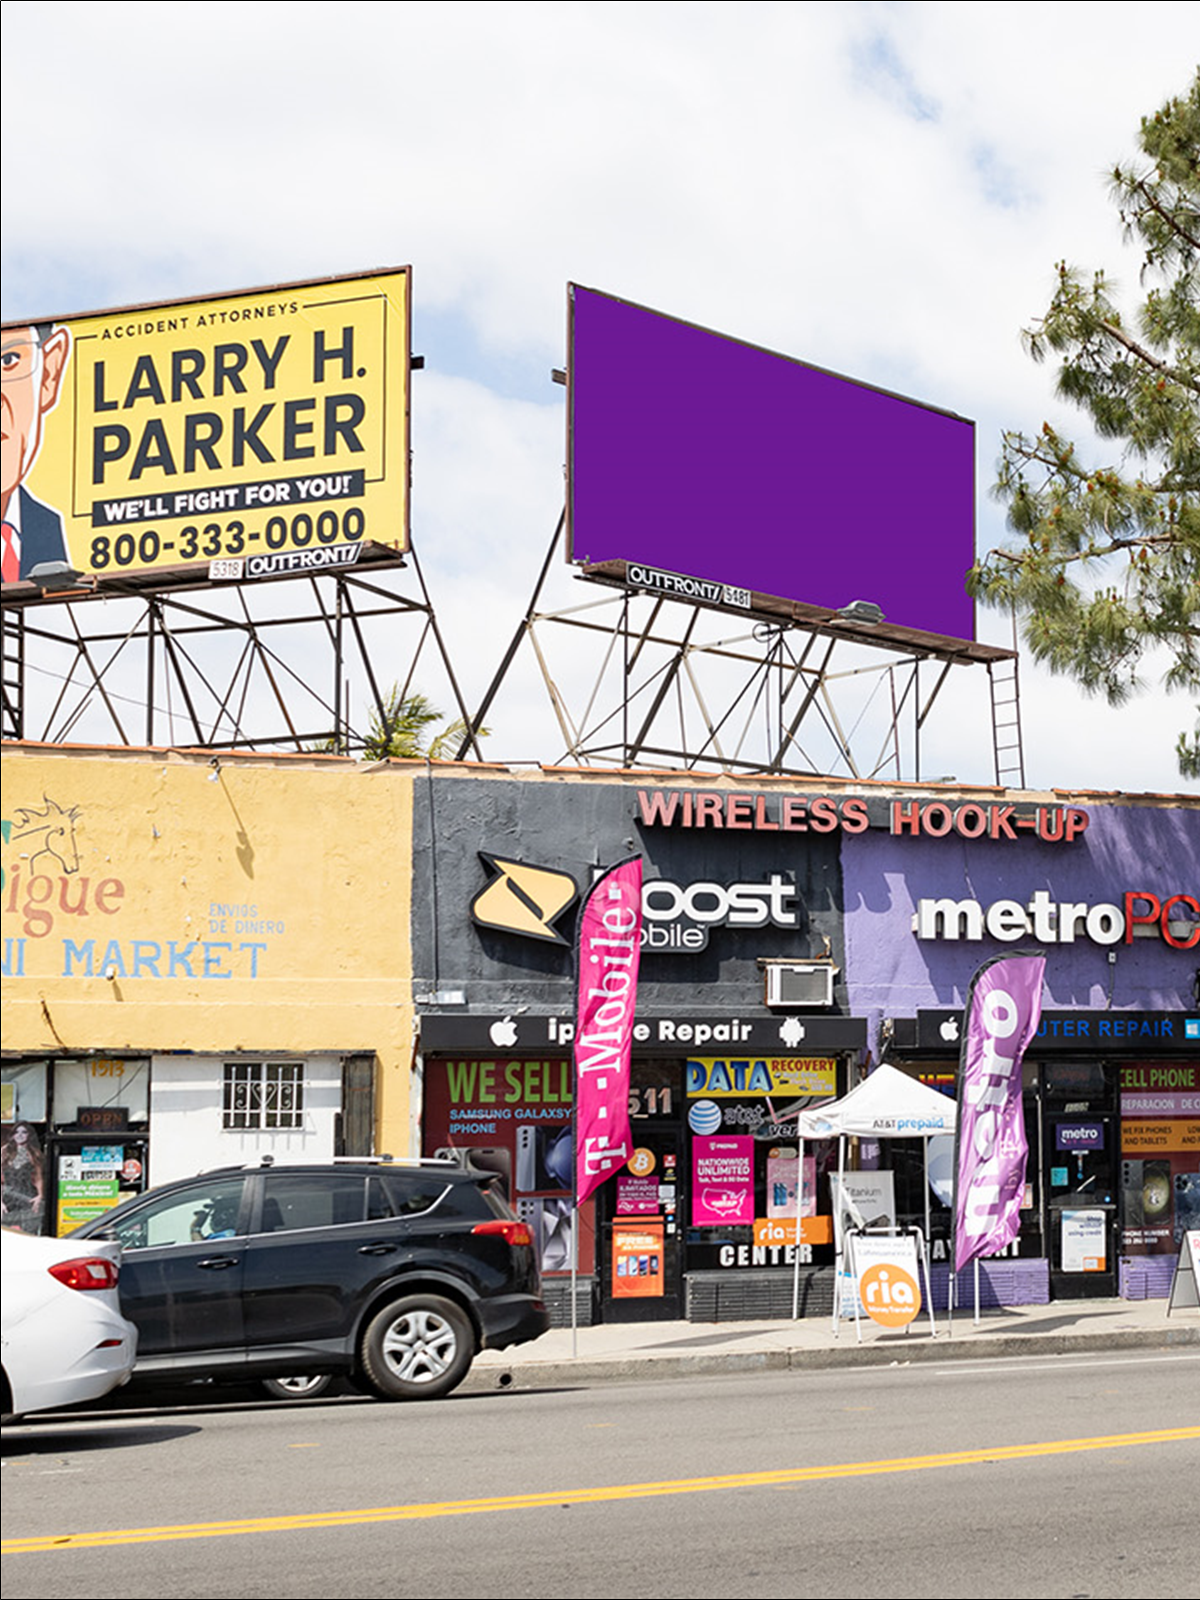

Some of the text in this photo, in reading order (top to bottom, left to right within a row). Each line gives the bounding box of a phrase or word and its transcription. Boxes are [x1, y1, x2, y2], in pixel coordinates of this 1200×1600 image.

[101, 302, 299, 341] ACCIDENT ATTORNEYS
[93, 326, 367, 413] LARRY H.
[92, 392, 365, 485] PARKER
[103, 475, 352, 522] WE'LL FIGHT FOR YOU!
[90, 507, 365, 569] 800-333-0000
[212, 561, 240, 577] 5318
[725, 586, 751, 607] 5481
[637, 789, 1090, 843] WIRELESS HOOK-UP
[1, 863, 126, 938] igue
[593, 868, 796, 925] oost
[209, 903, 259, 918] ENVIOS
[209, 920, 285, 934] DE DINERO
[640, 923, 704, 948] obile
[61, 940, 268, 979] MARKET
[659, 1020, 752, 1042] Repair
[1036, 1020, 1174, 1037] UTER REPAIR
[91, 1060, 125, 1078] 1513
[687, 1059, 835, 1092] DATA RECOVERY
[1150, 1068, 1195, 1087] PHONE
[446, 1061, 573, 1103] WE SELL
[1121, 1099, 1175, 1110] REPARACION
[1181, 1099, 1192, 1109] DE
[81, 1111, 122, 1129] OPEN
[450, 1108, 572, 1121] SAMSUNG GALAXSY
[873, 1117, 944, 1131] AT&T prepaid
[450, 1123, 496, 1134] IPHONE
[1062, 1129, 1098, 1141] metro
[1145, 1126, 1172, 1134] PHONES
[1182, 1136, 1196, 1144] AND
[697, 1157, 749, 1167] NATIONWIDE
[697, 1166, 750, 1176] UNLIMITED
[759, 1222, 785, 1240] ria
[719, 1244, 813, 1267] CENTER
[866, 1271, 915, 1304] ria
